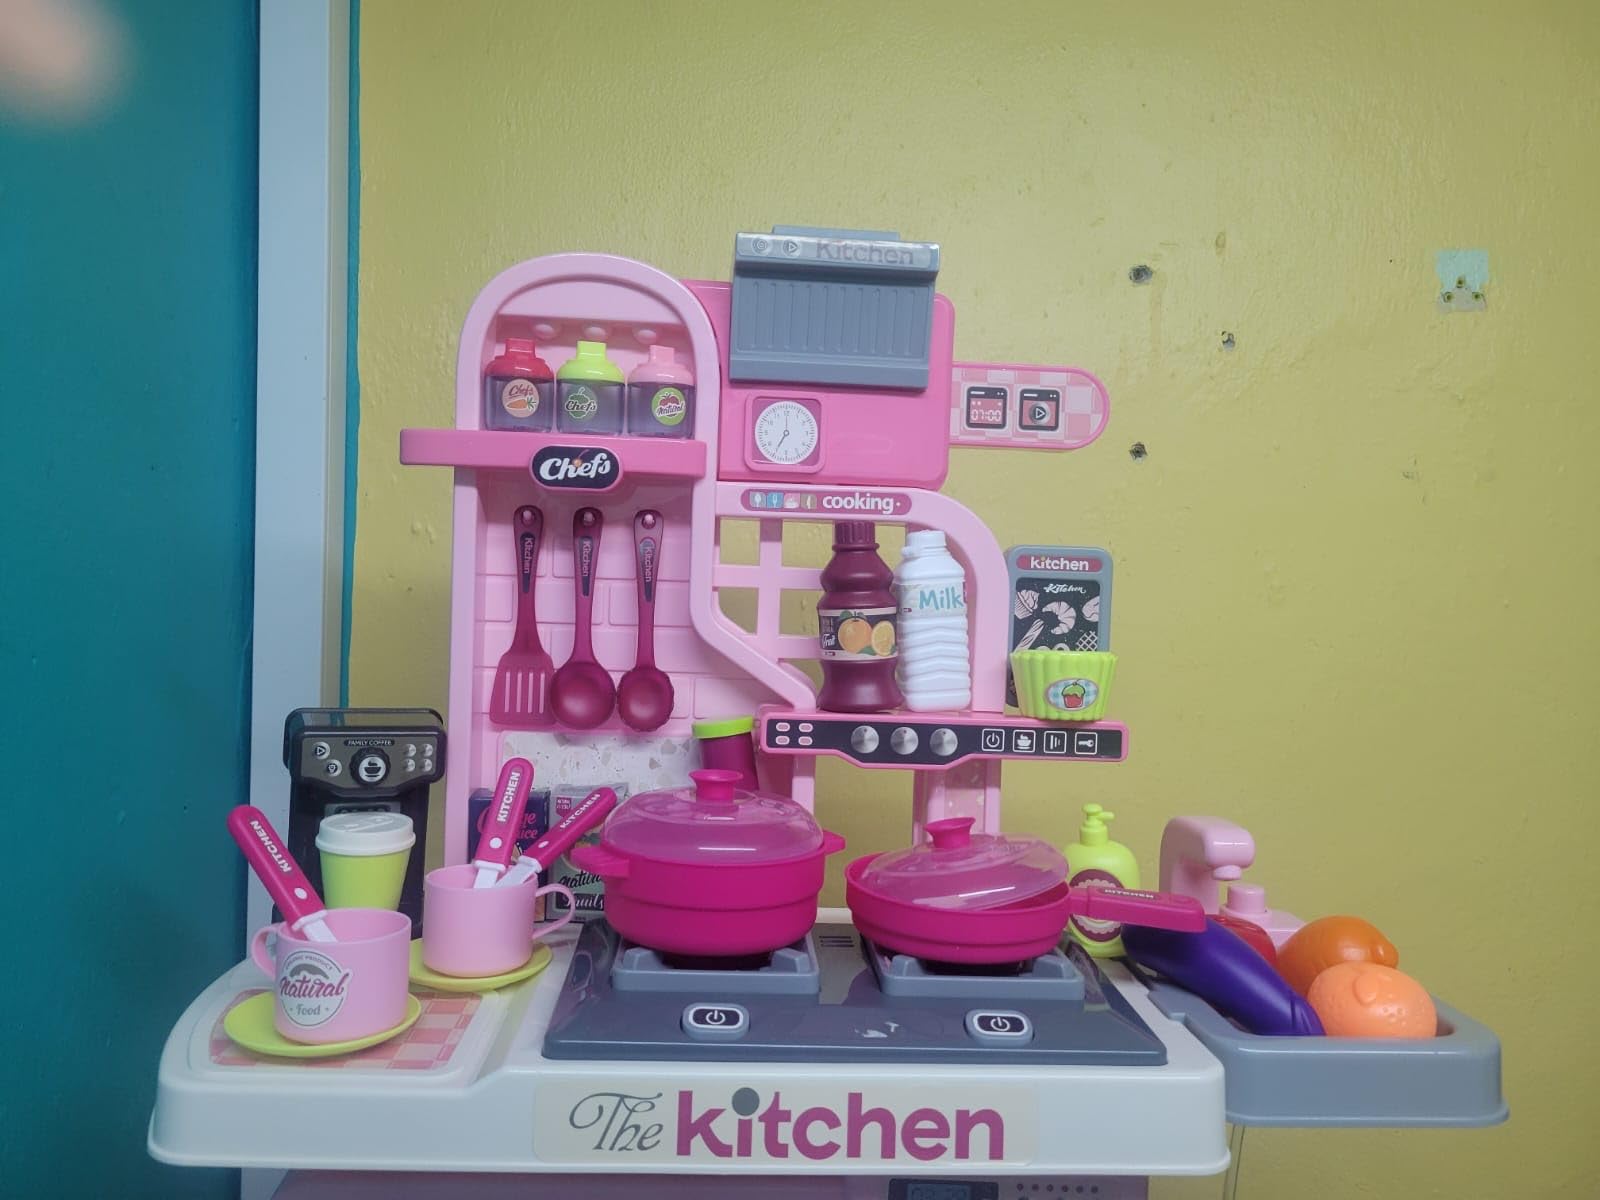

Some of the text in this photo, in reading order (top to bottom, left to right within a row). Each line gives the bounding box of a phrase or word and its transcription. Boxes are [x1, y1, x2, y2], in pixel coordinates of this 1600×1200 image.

[816, 239, 914, 265] Kitchen
[508, 385, 534, 398] Chefs
[565, 397, 598, 412] Chefs
[539, 452, 611, 480] Chefs
[823, 492, 894, 515] cooking
[524, 537, 533, 574] Kitchen
[582, 540, 592, 577] Kitchen
[645, 546, 654, 583] Kitchen
[1030, 556, 1089, 571] kitchen
[919, 586, 964, 610] Milk
[1043, 583, 1087, 594] Kitchen
[497, 772, 520, 823] KITCHEN
[560, 794, 601, 829] KITCHEN
[250, 820, 292, 872] KITCHEN
[569, 1087, 1004, 1161] The kitchen
